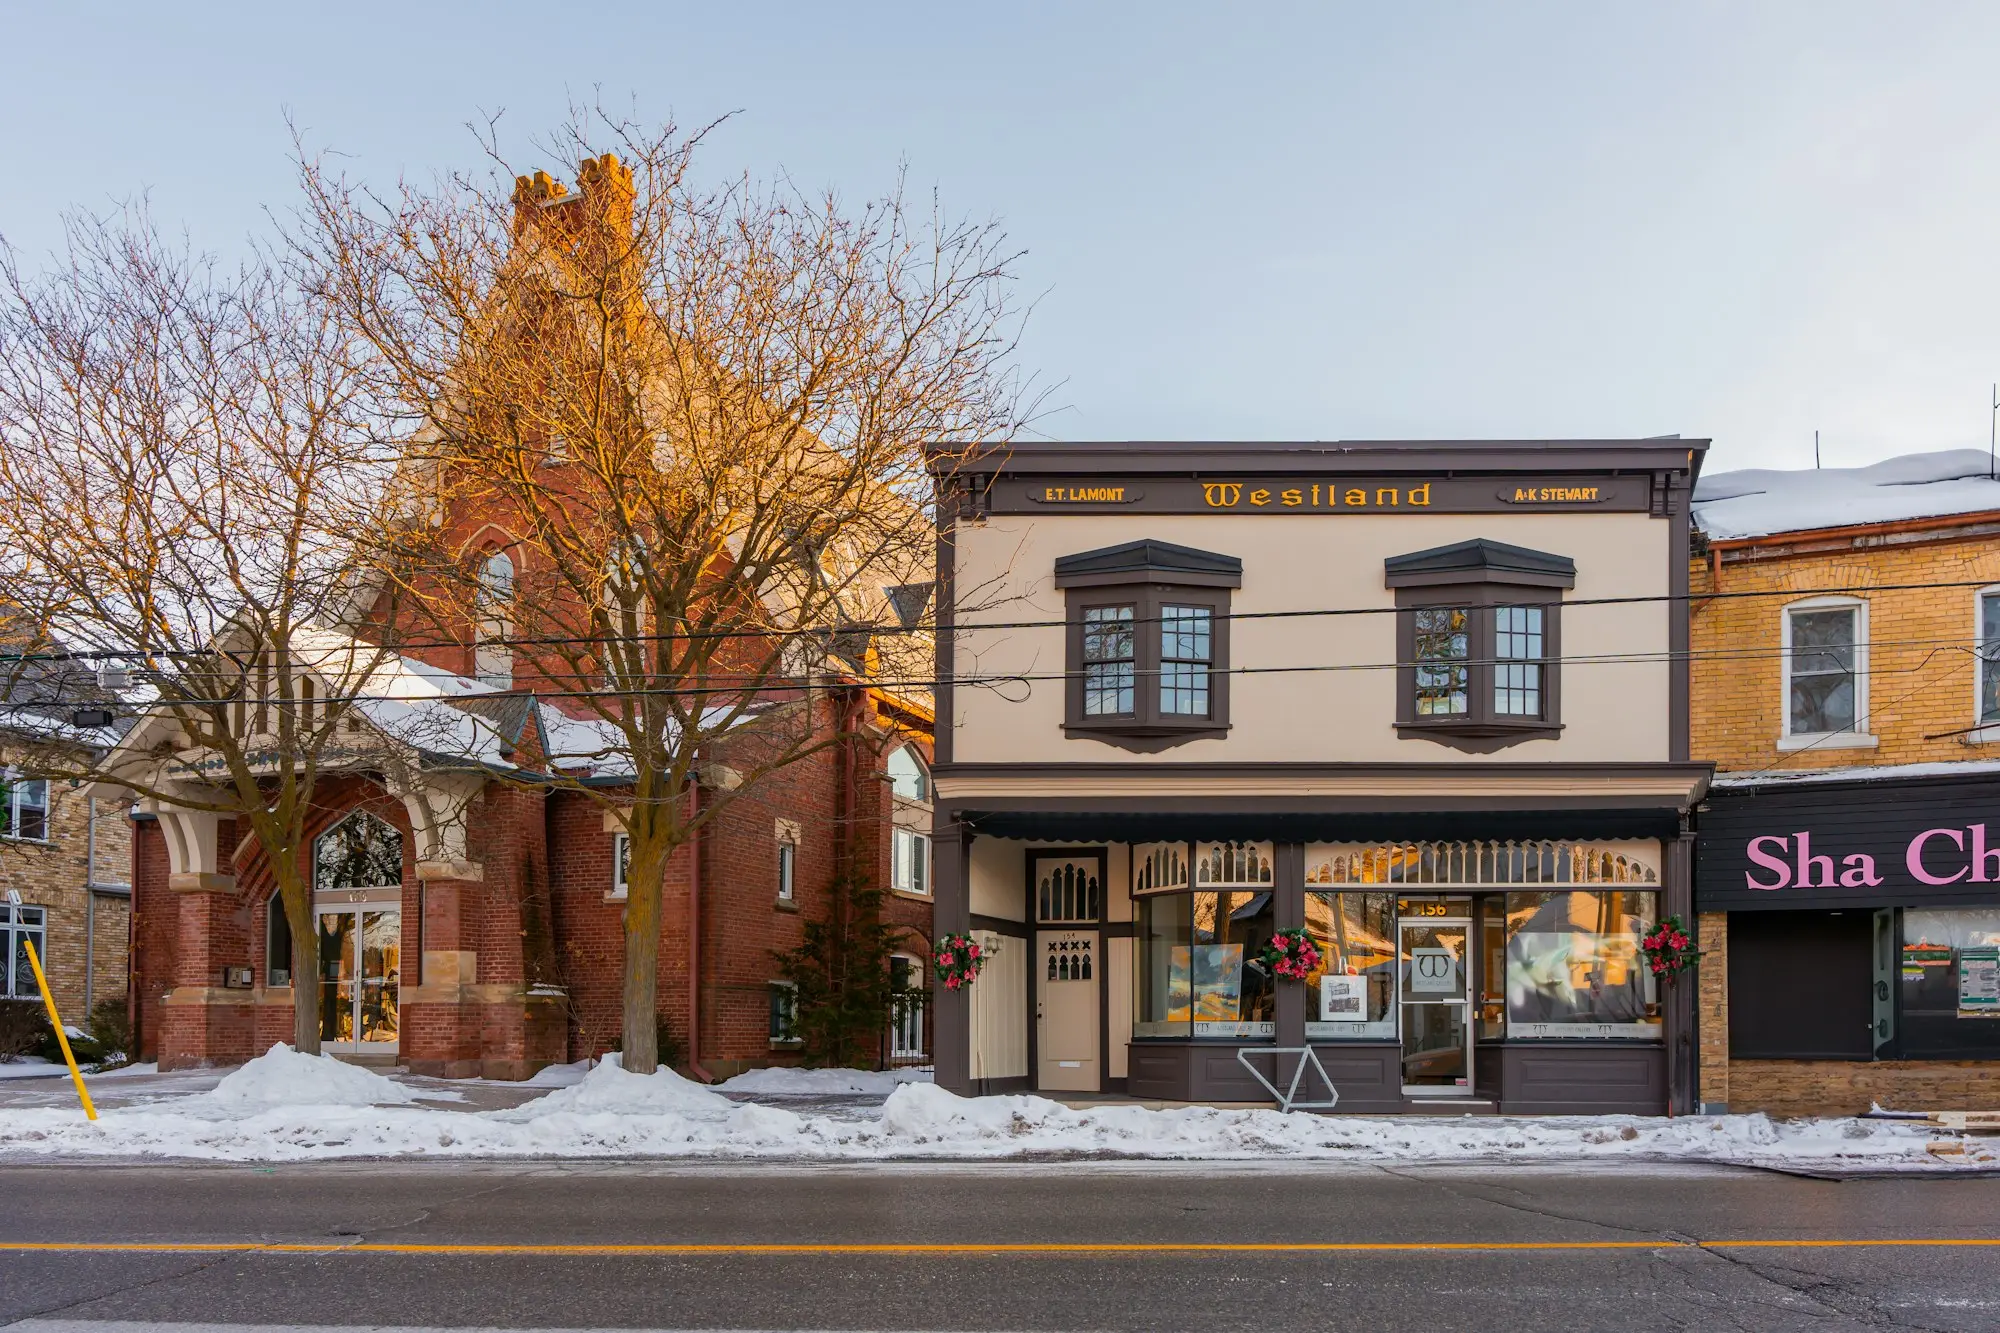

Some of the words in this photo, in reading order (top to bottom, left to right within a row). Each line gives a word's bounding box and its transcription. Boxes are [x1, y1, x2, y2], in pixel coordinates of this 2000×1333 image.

[1045, 487, 1066, 501] E.T.
[1069, 487, 1125, 501] LAMONT
[1202, 482, 1432, 508] Westland
[1540, 487, 1599, 501] STEWART
[1744, 830, 1885, 891] Sha
[1905, 823, 2000, 886] Ch
[1420, 903, 1447, 917] 156
